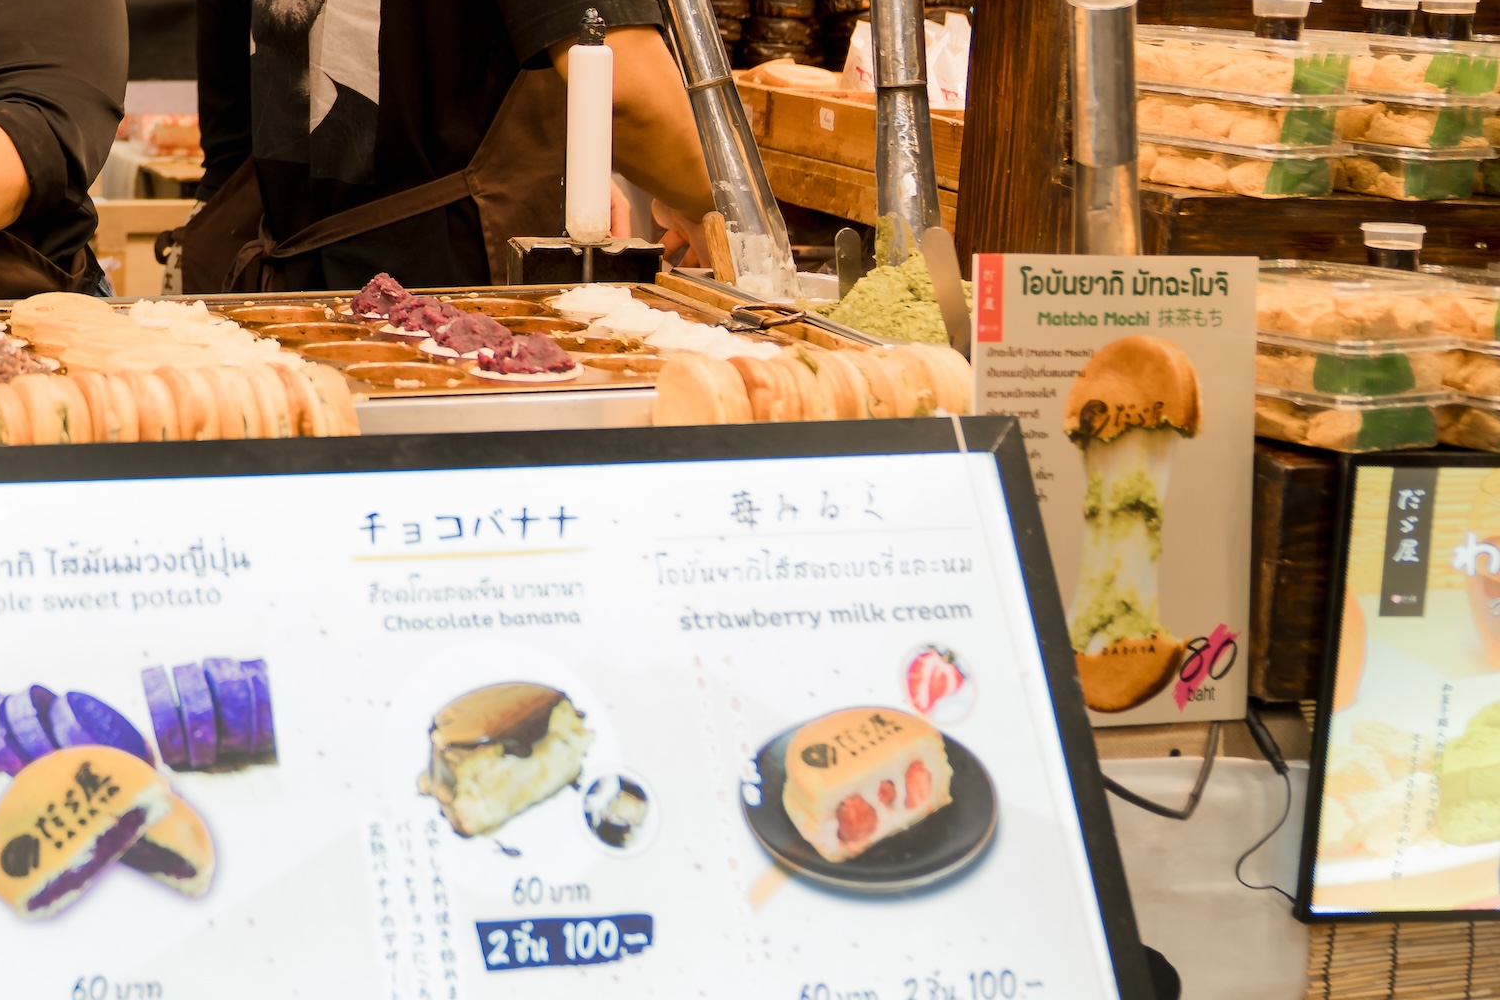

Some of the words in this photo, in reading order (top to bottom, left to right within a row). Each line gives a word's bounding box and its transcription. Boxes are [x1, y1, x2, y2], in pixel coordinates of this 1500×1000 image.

[1020, 266, 1124, 296] โอบันยากิ
[1132, 268, 1229, 297] มัทฉะโมจิ
[1037, 311, 1098, 327] Matcha
[1104, 311, 1150, 327] Mochi
[1158, 308, 1223, 328] 抹茶もち
[359, 506, 579, 545] チョコバナナ
[43, 589, 121, 612] sweet
[132, 586, 222, 612] potato
[383, 612, 494, 632] Chocolate
[500, 609, 581, 627] banana
[680, 607, 822, 630] strawberry
[829, 602, 887, 624] milk
[893, 602, 973, 622] cream
[1180, 636, 1238, 683] 80
[1188, 685, 1216, 702] baht
[512, 876, 543, 905] 60
[487, 929, 511, 966] 2
[71, 974, 108, 1000] 60
